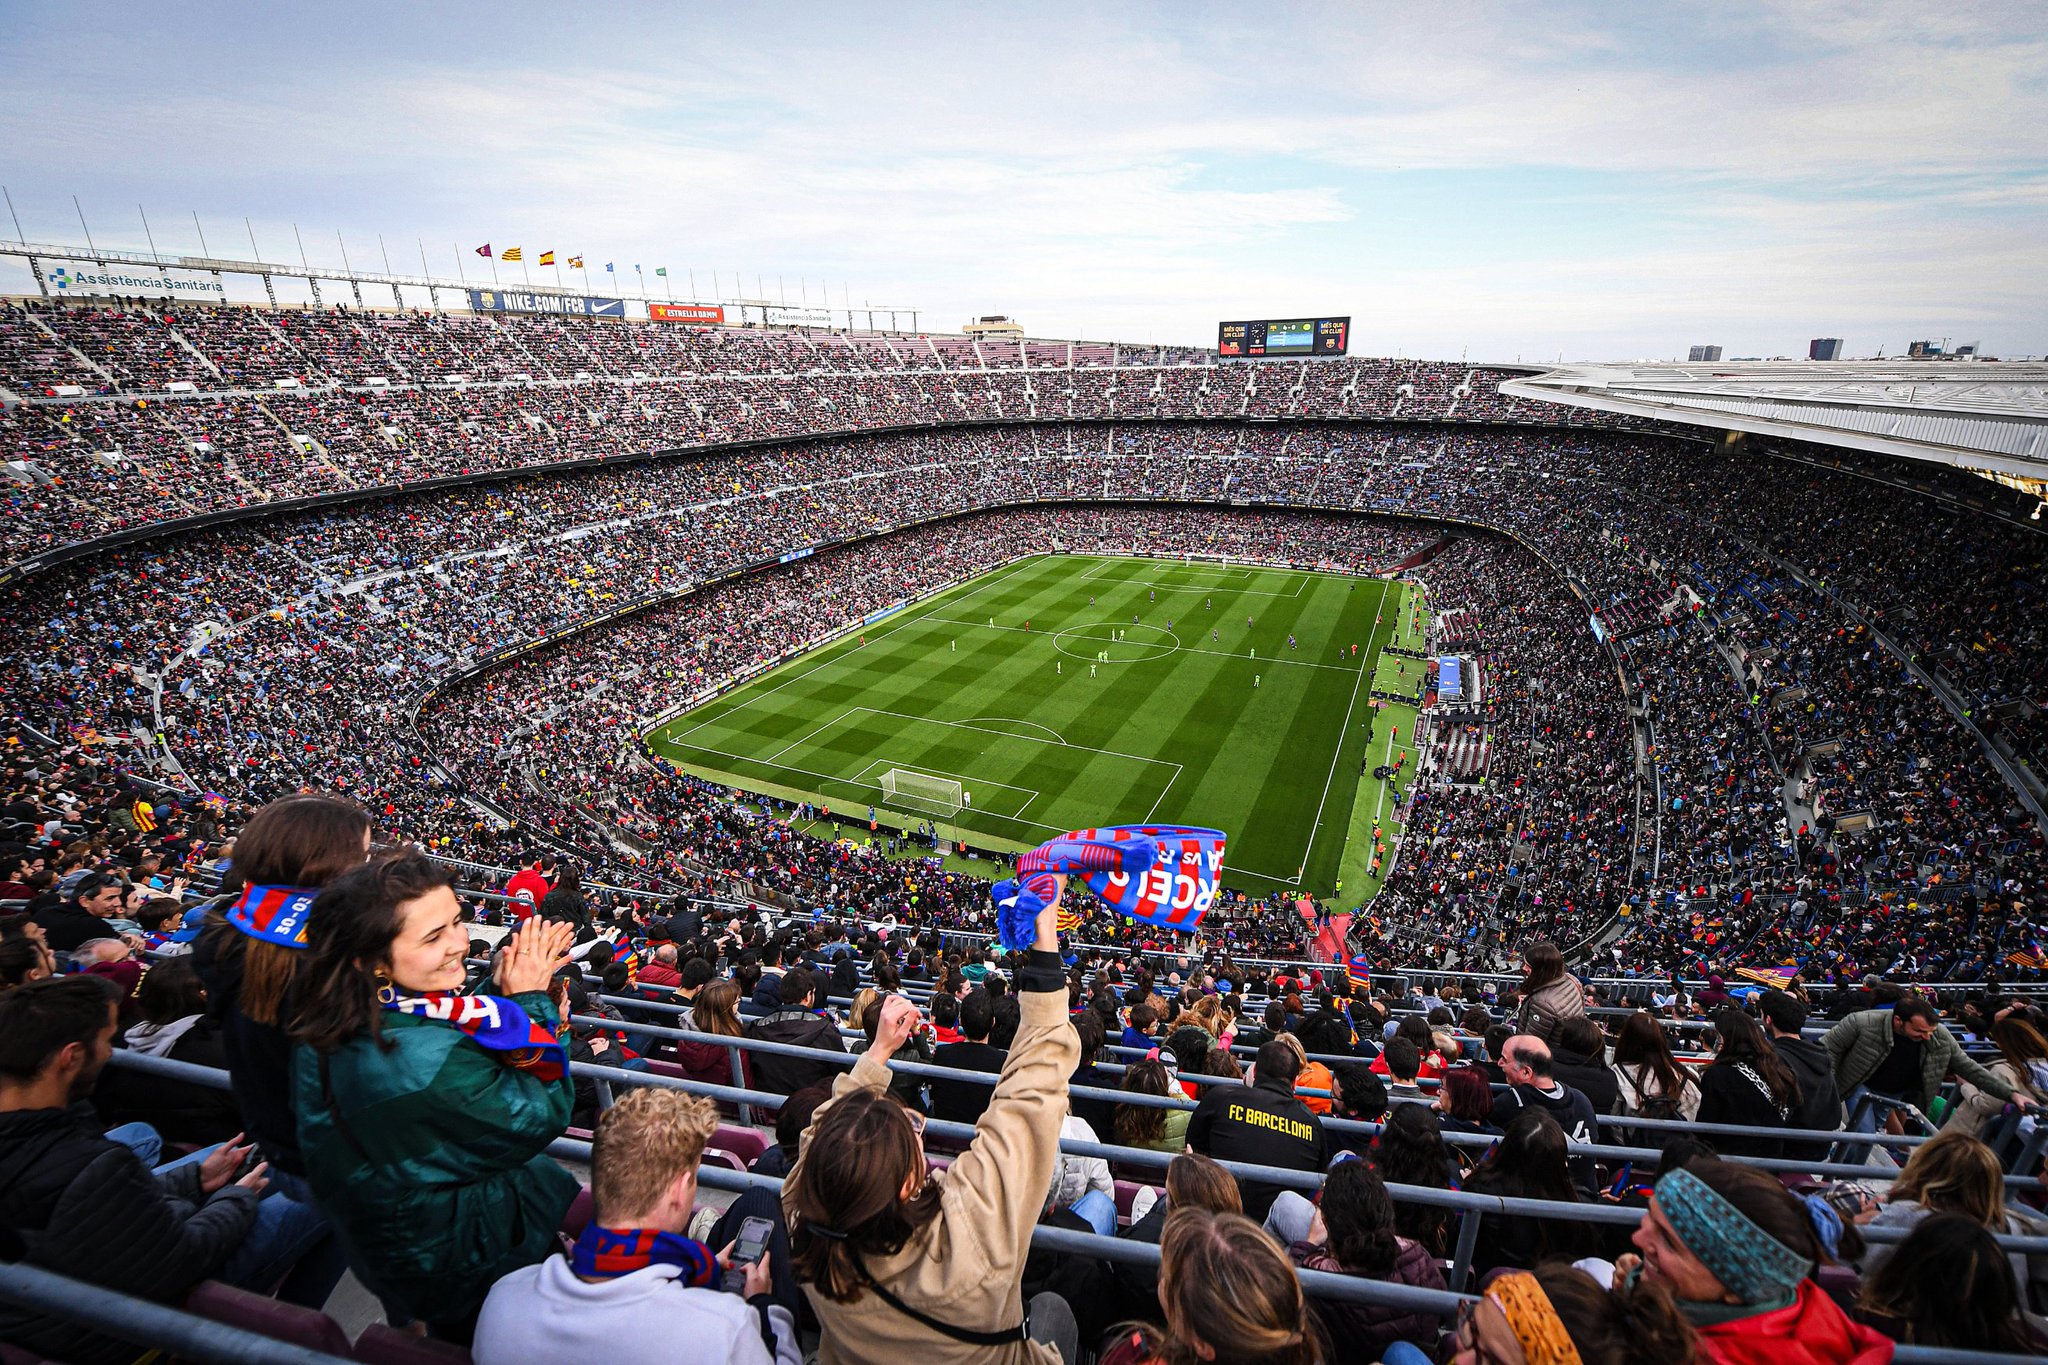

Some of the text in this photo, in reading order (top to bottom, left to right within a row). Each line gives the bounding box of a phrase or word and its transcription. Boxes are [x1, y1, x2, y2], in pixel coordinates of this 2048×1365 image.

[76, 272, 223, 292] Assistència Sanitària
[503, 294, 585, 313] NIKE.COM/FCB
[667, 309, 698, 318] ESTRELLA
[274, 897, 312, 935] 30-03
[1229, 1104, 1313, 1142] FC BARCELONA
